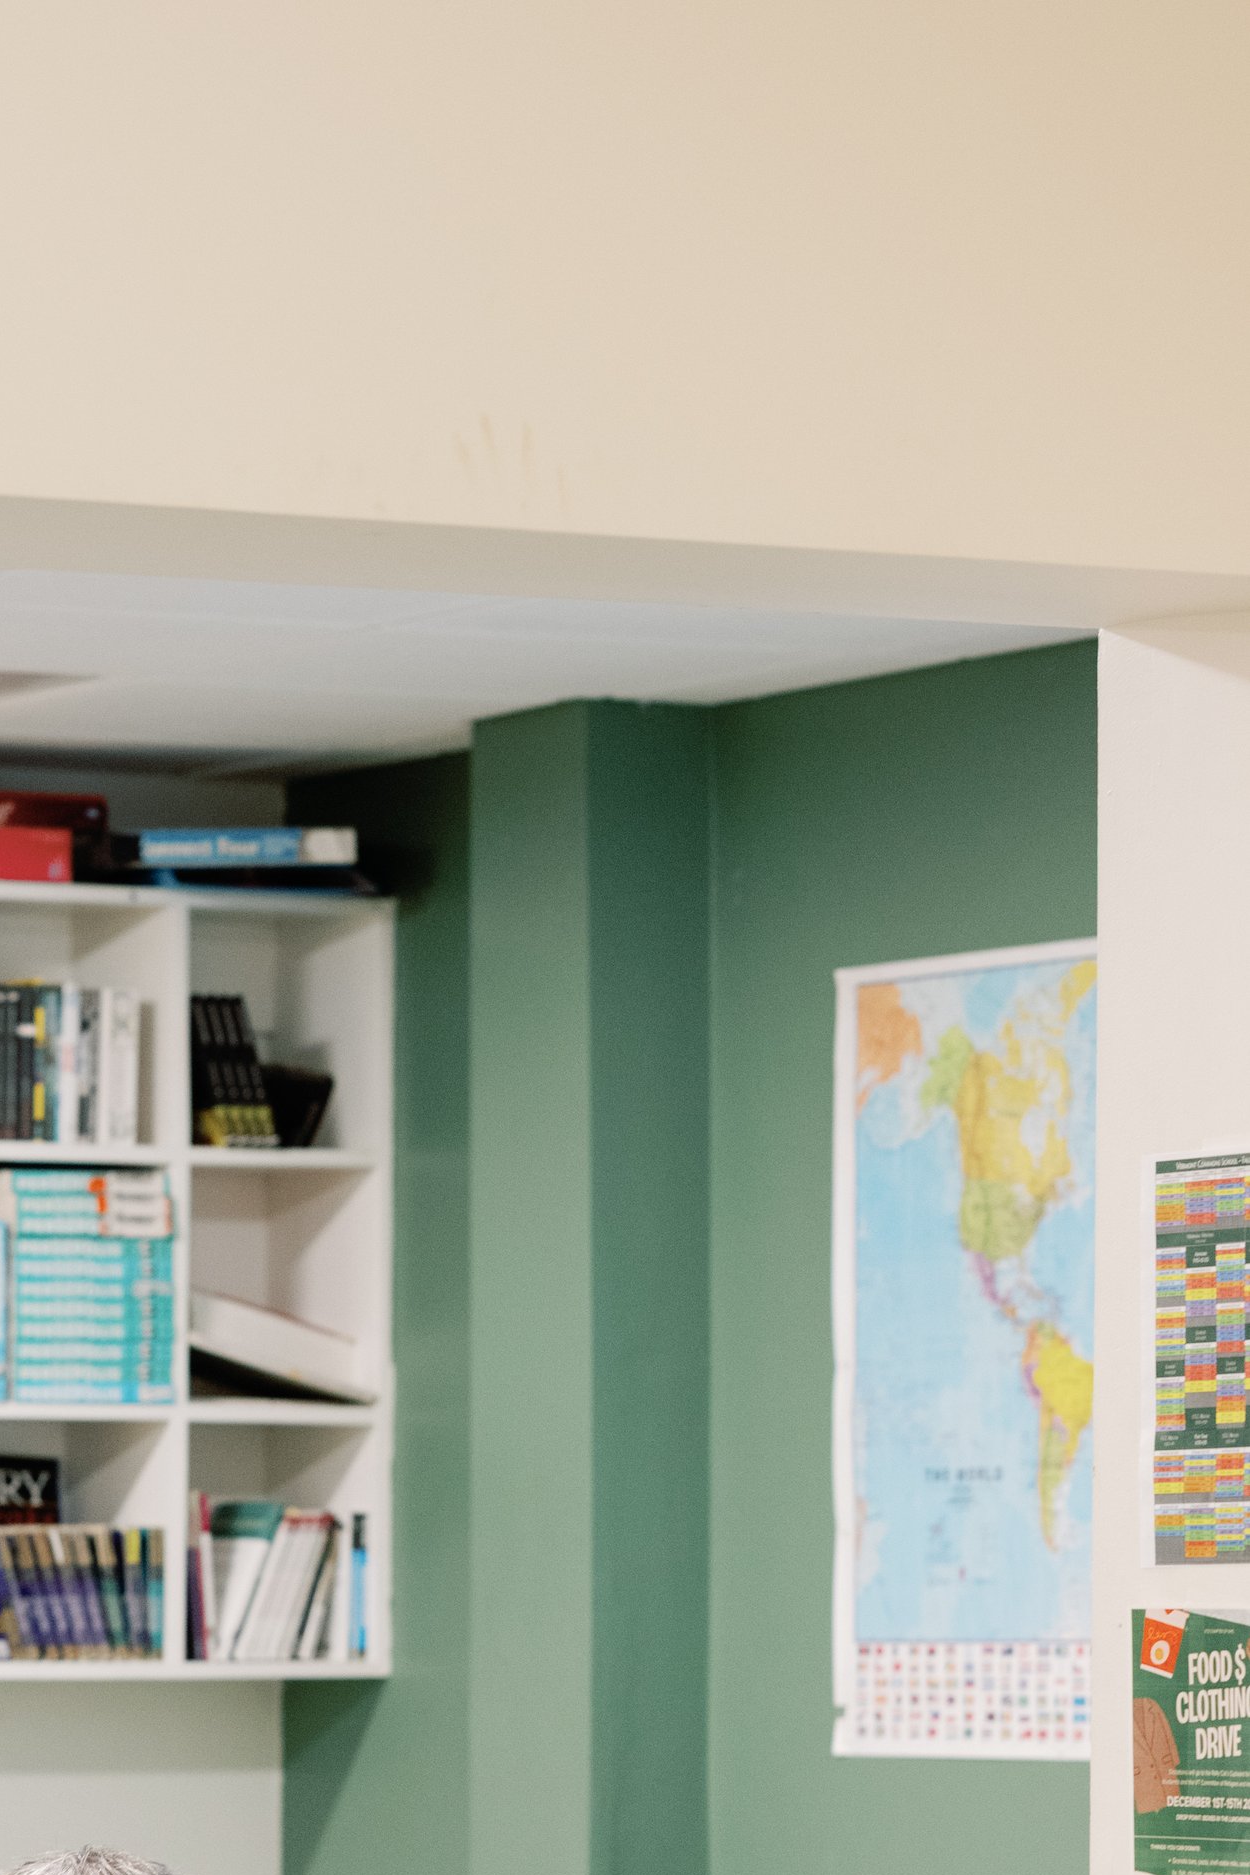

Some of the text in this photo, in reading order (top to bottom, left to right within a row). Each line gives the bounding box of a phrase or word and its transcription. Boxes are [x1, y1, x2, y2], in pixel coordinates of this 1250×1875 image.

[1187, 1650, 1233, 1685] FOOD
[1195, 1724, 1242, 1760] DRIVE
[1166, 1795, 1211, 1808] DECEMBER
